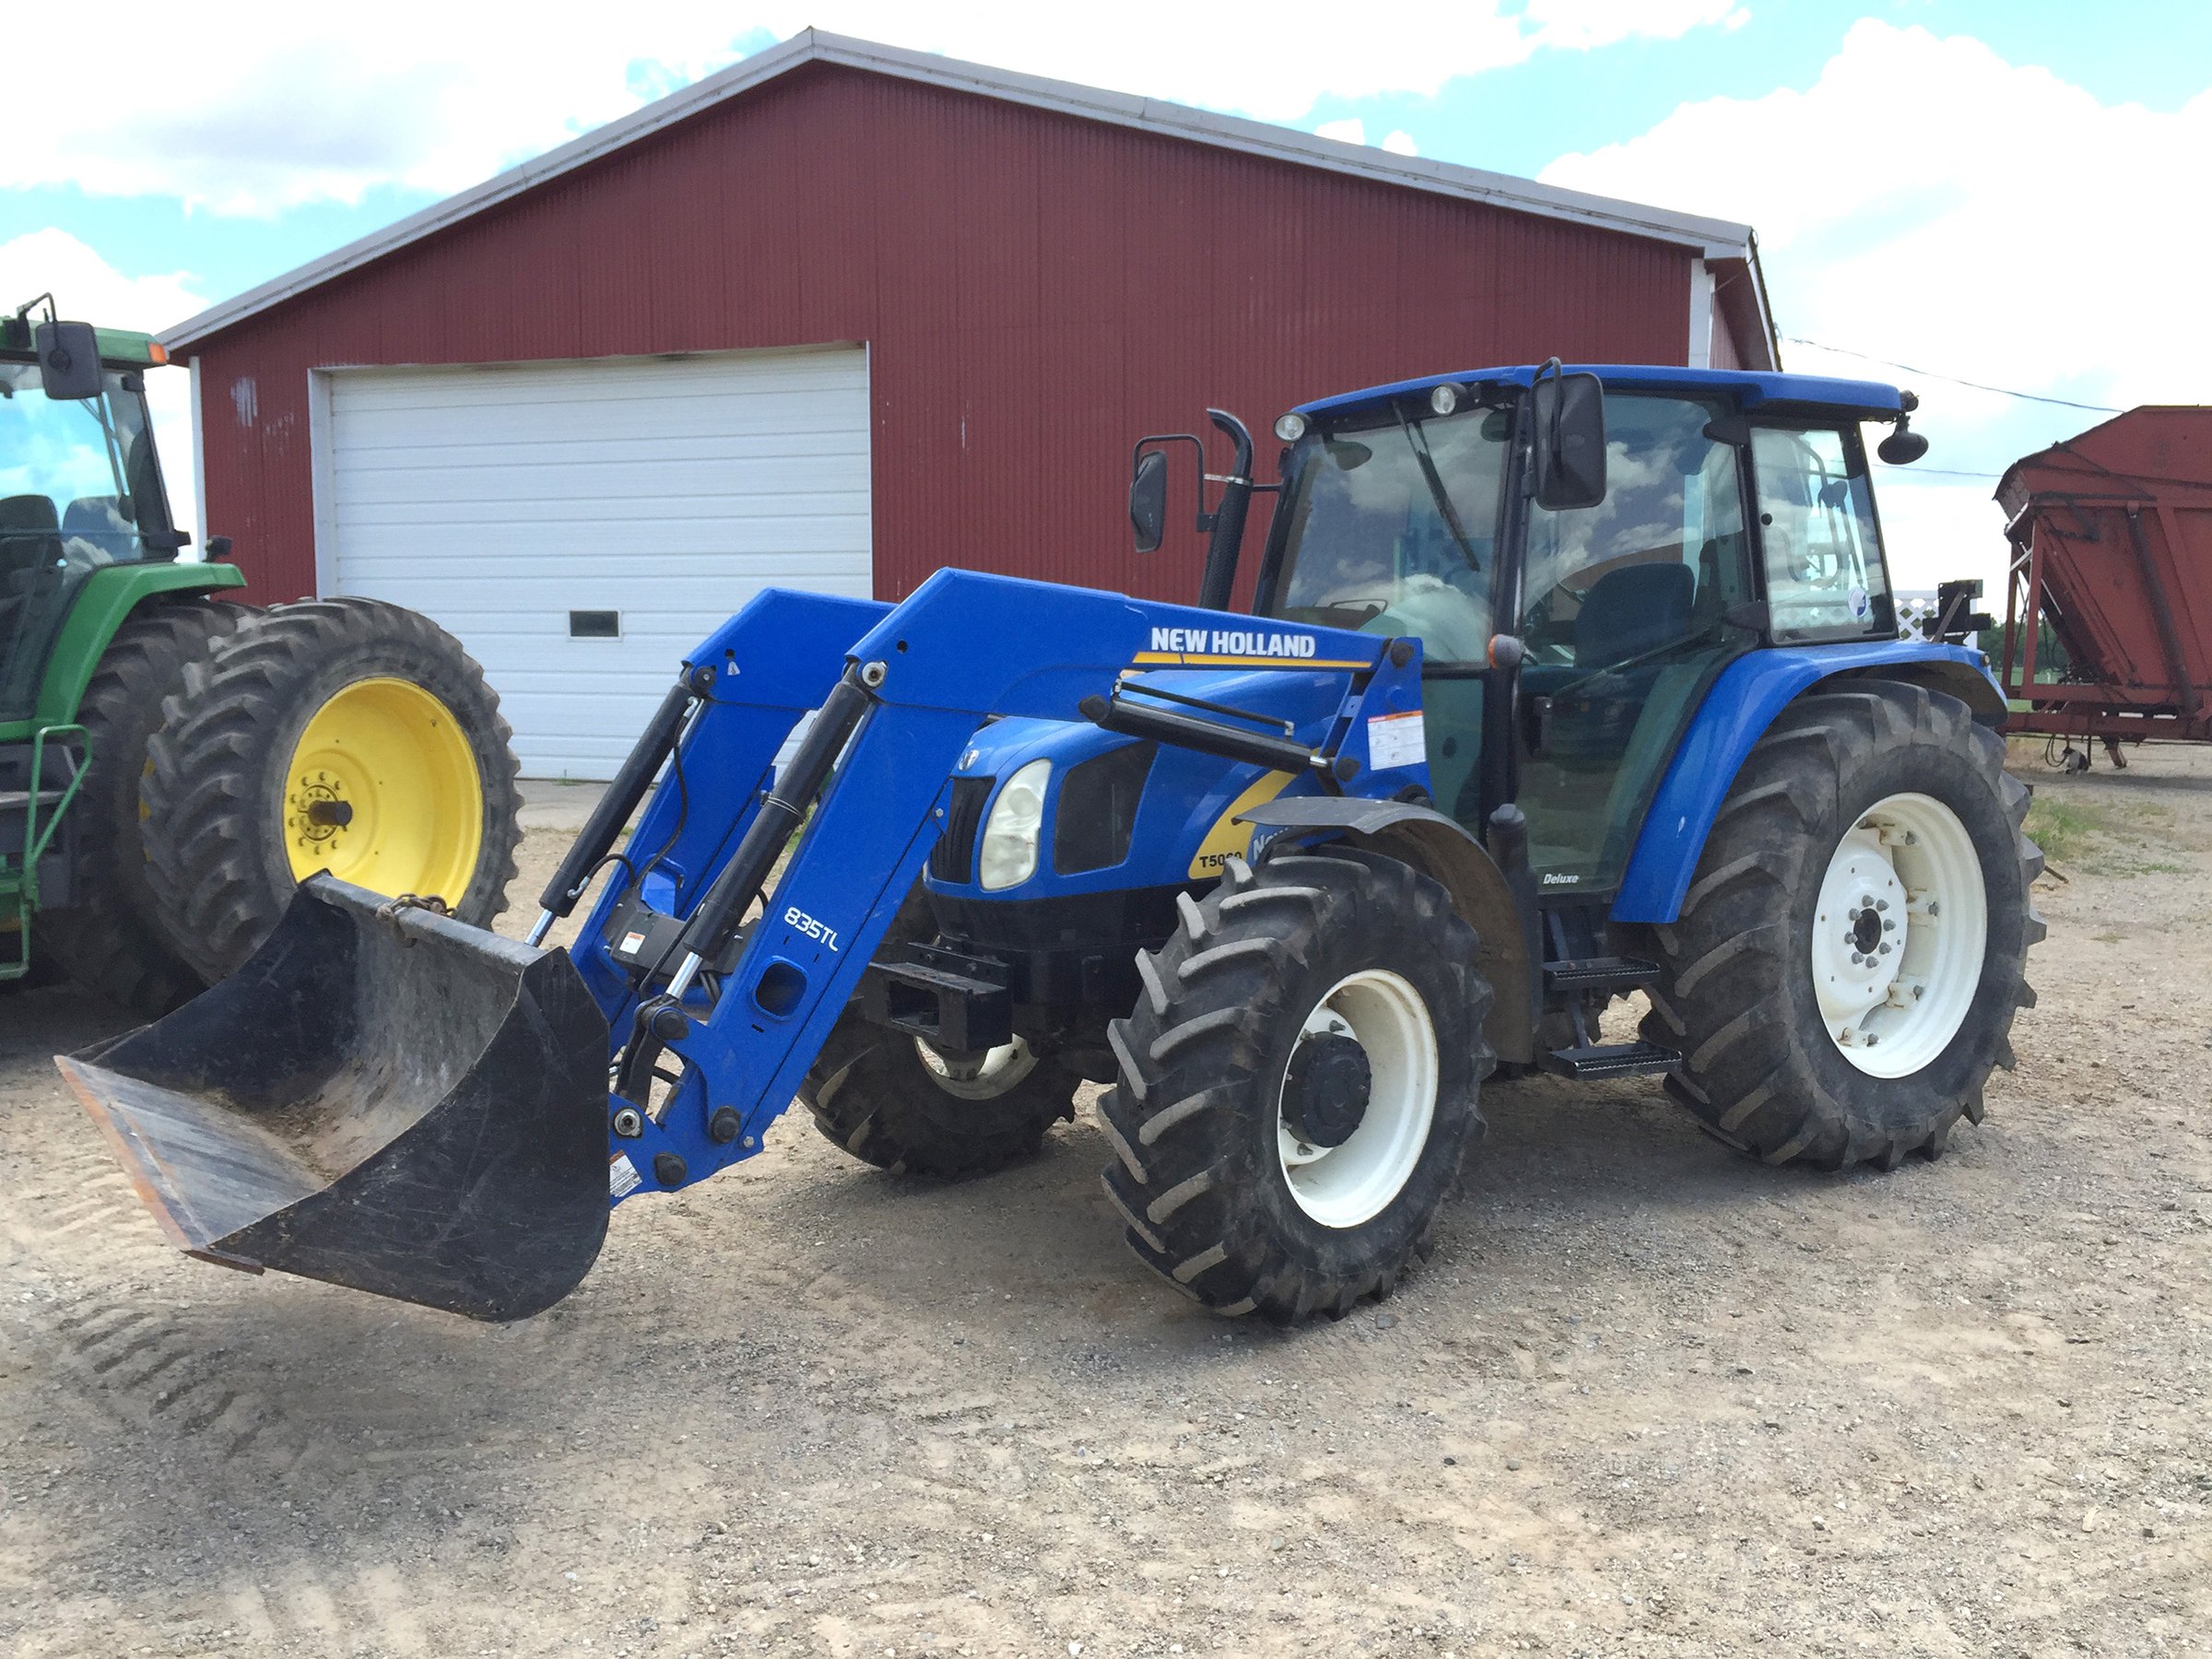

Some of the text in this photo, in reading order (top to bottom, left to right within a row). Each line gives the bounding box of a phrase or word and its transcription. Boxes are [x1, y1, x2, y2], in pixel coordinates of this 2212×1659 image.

[1151, 627, 1316, 658] NEW HOLLAND
[1543, 873, 1579, 885] Deluxe
[784, 906, 839, 952] 835TL
